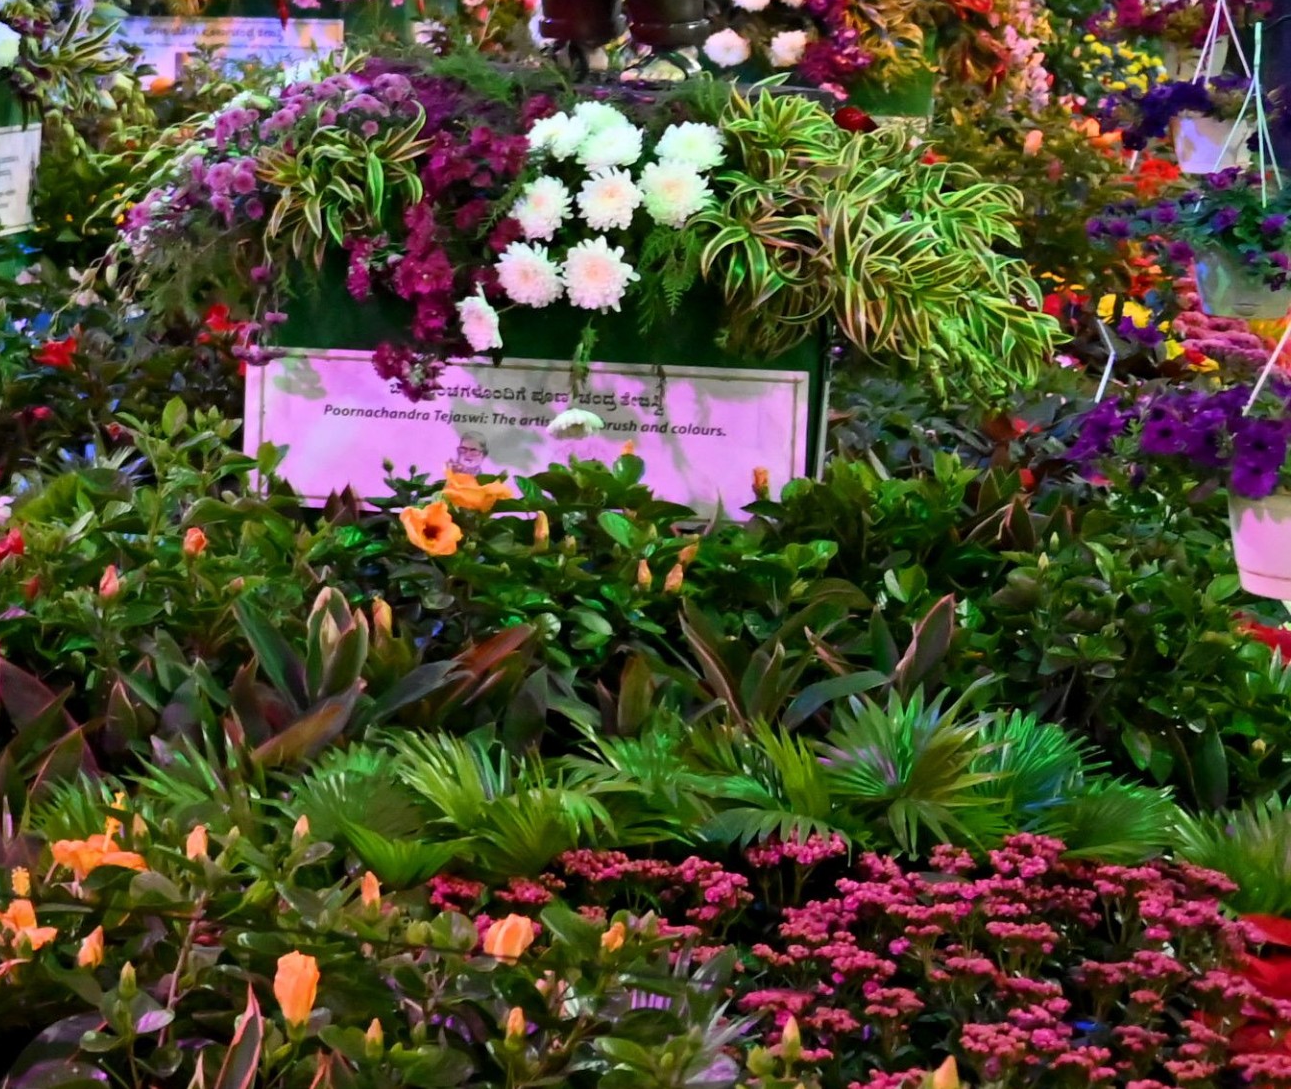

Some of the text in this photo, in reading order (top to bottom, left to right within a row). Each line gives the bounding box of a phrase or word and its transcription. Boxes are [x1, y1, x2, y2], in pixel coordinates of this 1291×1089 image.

[323, 404, 430, 421] Poornachandra
[434, 409, 488, 425] Tejaswi:
[493, 412, 516, 426] The
[519, 414, 554, 427] artis
[639, 421, 668, 434] and
[671, 423, 727, 437] colours.
